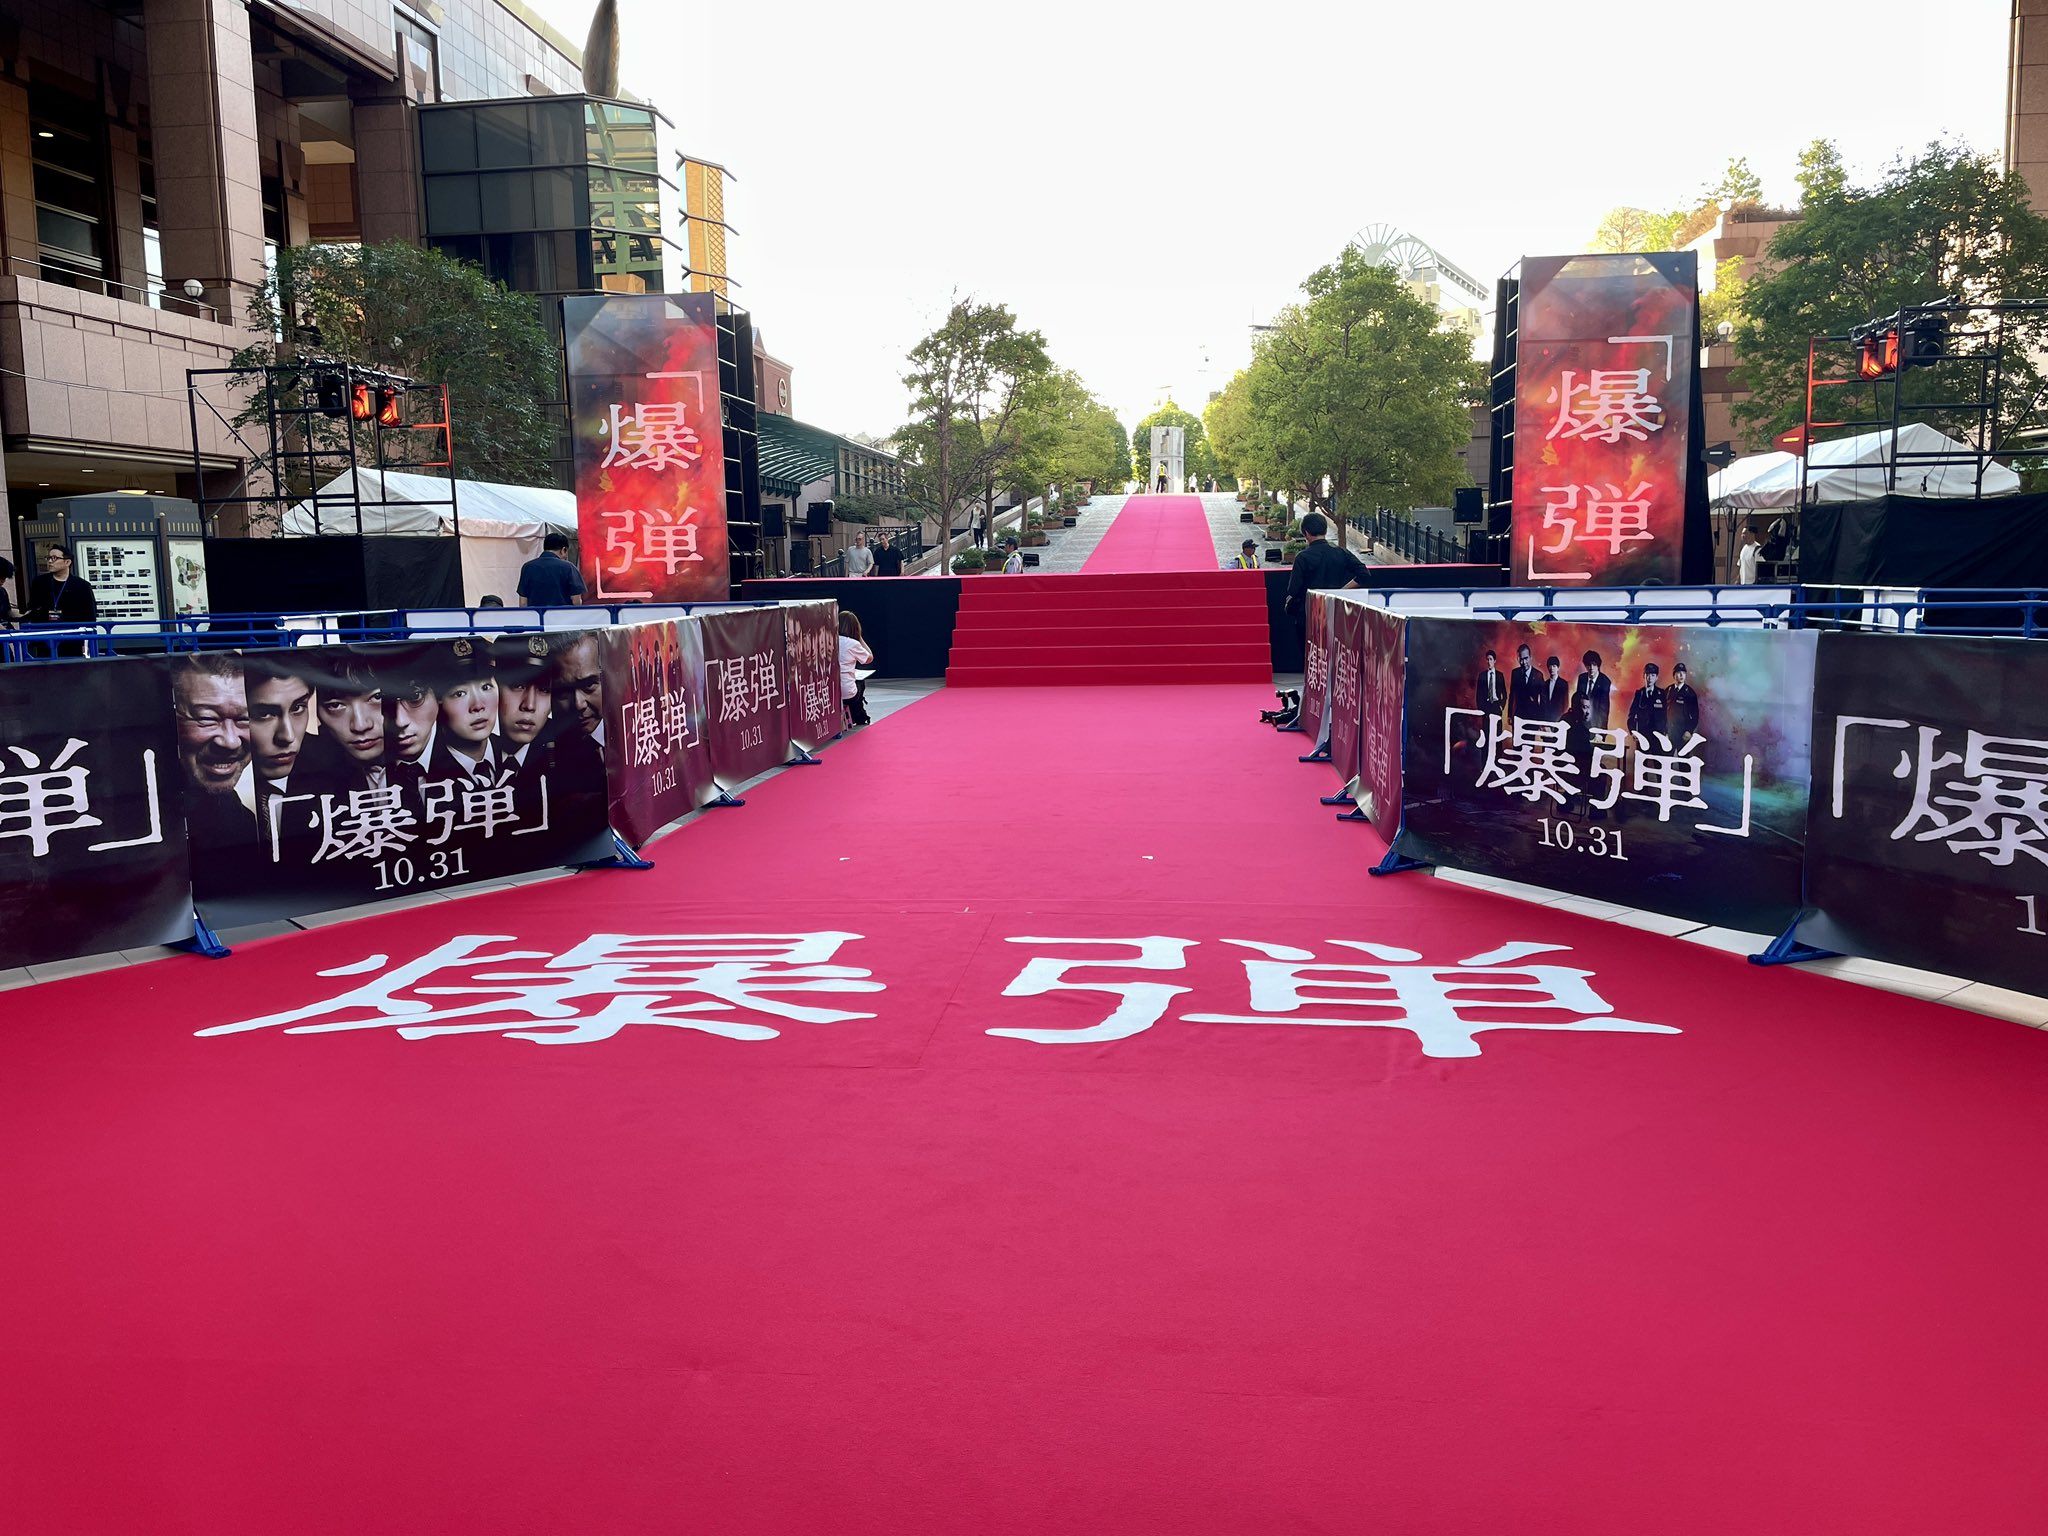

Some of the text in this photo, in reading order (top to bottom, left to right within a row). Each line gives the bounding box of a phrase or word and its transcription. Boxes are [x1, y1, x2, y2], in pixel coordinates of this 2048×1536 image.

[595, 370, 704, 599] 「爆弾」
[1527, 334, 1674, 580] 「爆弾」
[704, 649, 787, 723] 「爆弾」
[800, 677, 835, 722] 「爆弾」
[621, 687, 700, 768] 「爆弾」
[740, 724, 764, 751] 10.31
[651, 765, 677, 797] 10.31
[1443, 706, 1754, 838] 「爆弾」
[268, 769, 549, 864] 「爆弾」
[1537, 817, 1629, 862] 10.31
[372, 847, 470, 891] 10.31
[193, 931, 1684, 1058] 爆弾
